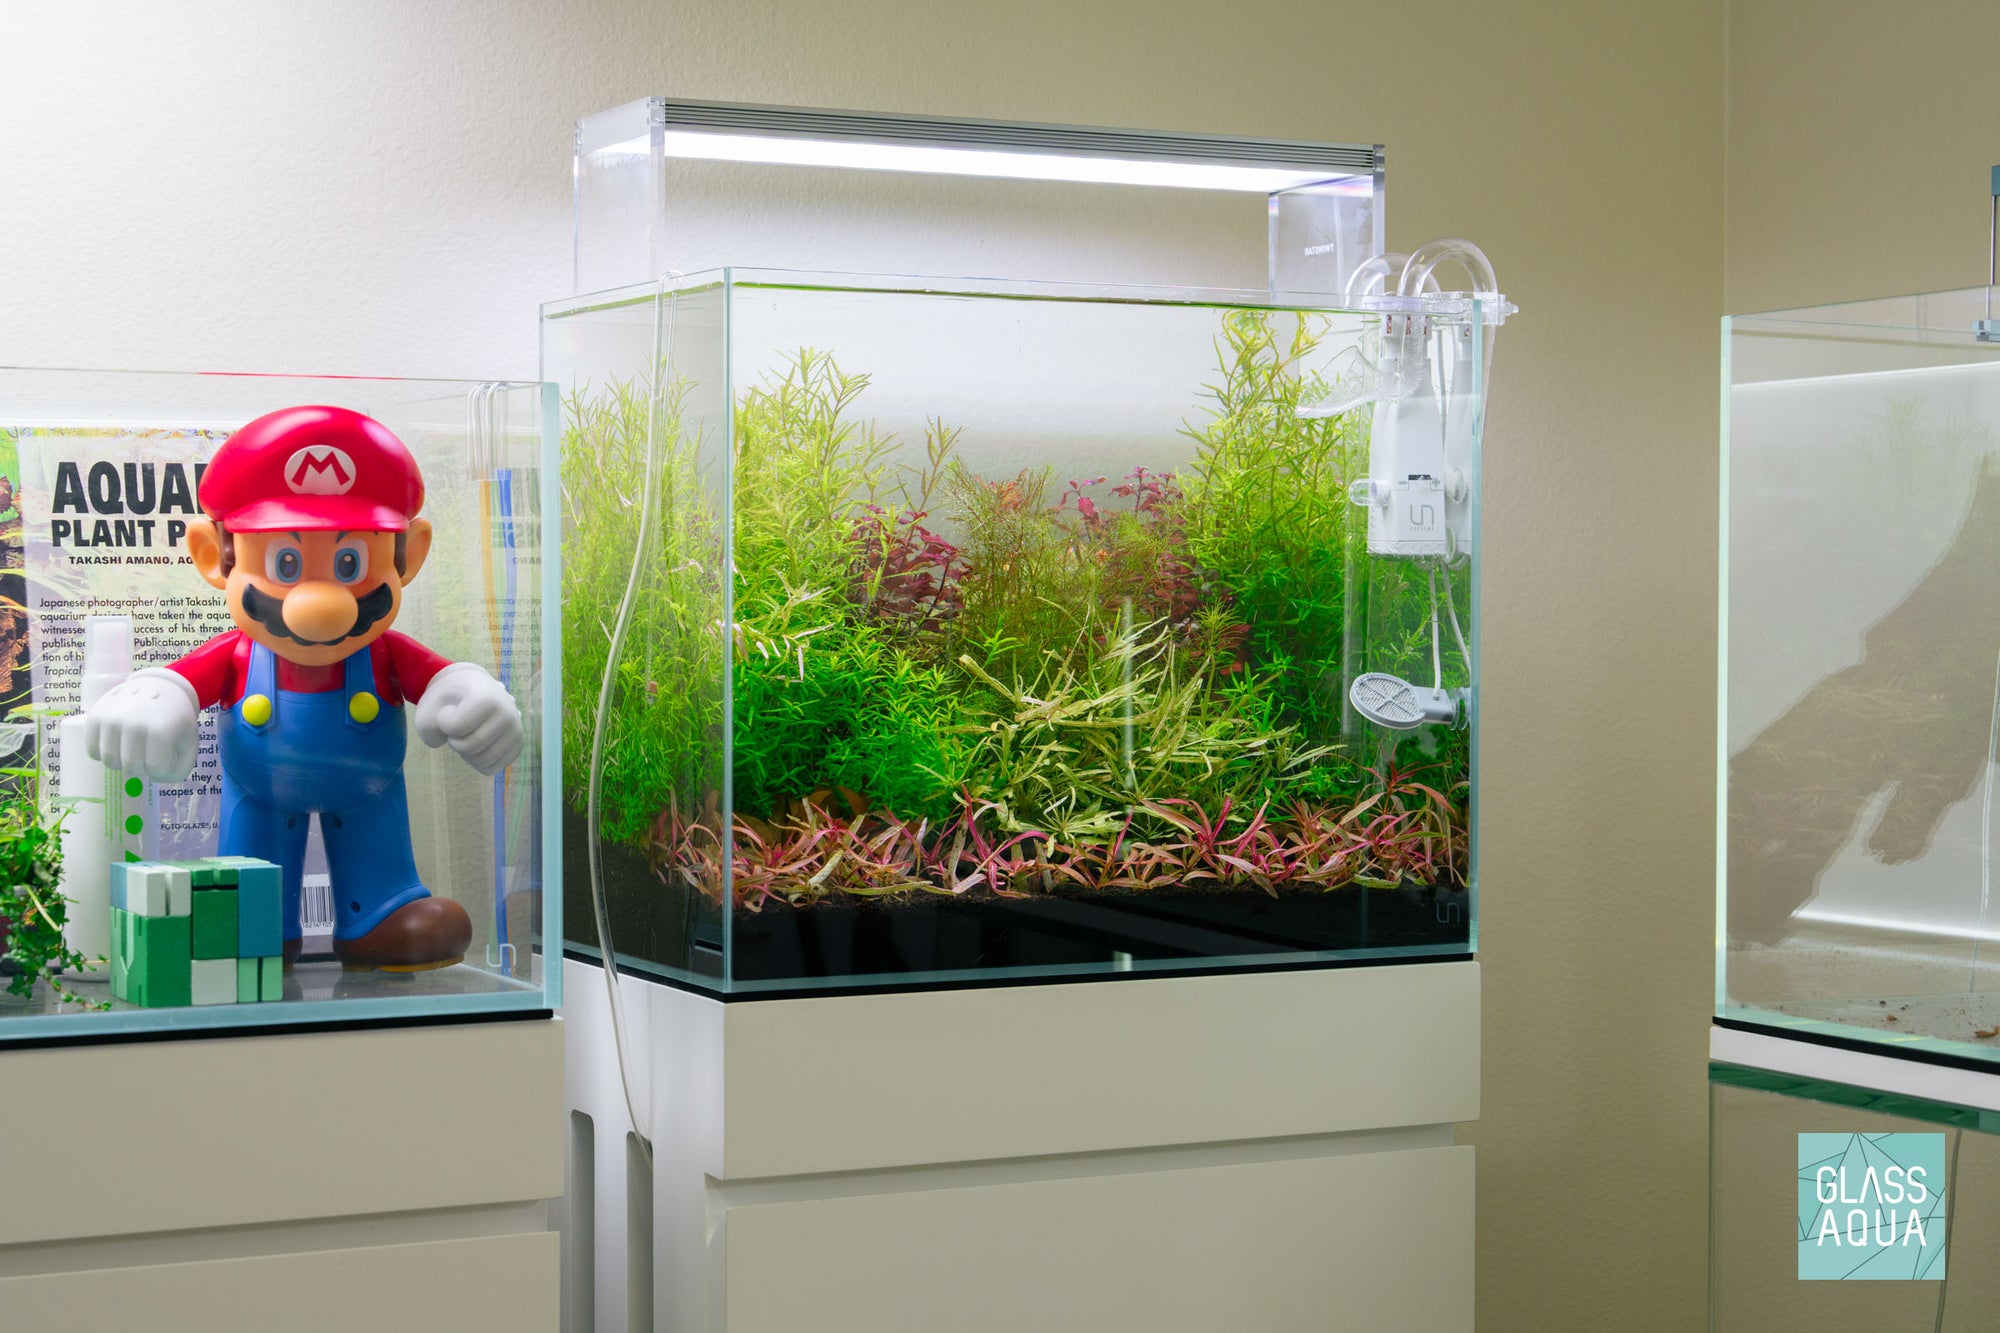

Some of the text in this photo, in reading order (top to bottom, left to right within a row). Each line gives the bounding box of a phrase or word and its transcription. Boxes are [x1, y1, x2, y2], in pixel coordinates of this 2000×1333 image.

[51, 519, 187, 547] PLANT P
[69, 556, 122, 565] TAKASHI
[126, 556, 174, 566] AMANO,
[40, 598, 86, 609] Japanese
[87, 597, 184, 609] photographer/artist
[185, 597, 221, 607] Takashi
[131, 610, 155, 620] have
[158, 610, 185, 620] taken
[188, 610, 203, 620] the
[206, 612, 231, 622] aqua
[134, 625, 164, 634] uccess
[168, 623, 178, 633] of
[182, 624, 195, 633] his
[199, 624, 224, 633] three
[134, 637, 190, 647] Publications
[42, 652, 60, 661] tion
[63, 651, 73, 661] of
[75, 651, 85, 661] hi
[132, 651, 147, 660] nd
[149, 650, 181, 662] photos
[44, 665, 82, 677] Tropical
[44, 695, 66, 703] own
[46, 720, 56, 731] of
[204, 716, 214, 727] of
[199, 731, 217, 741] size
[201, 760, 217, 768] not
[191, 771, 212, 784] they
[197, 784, 207, 796] of
